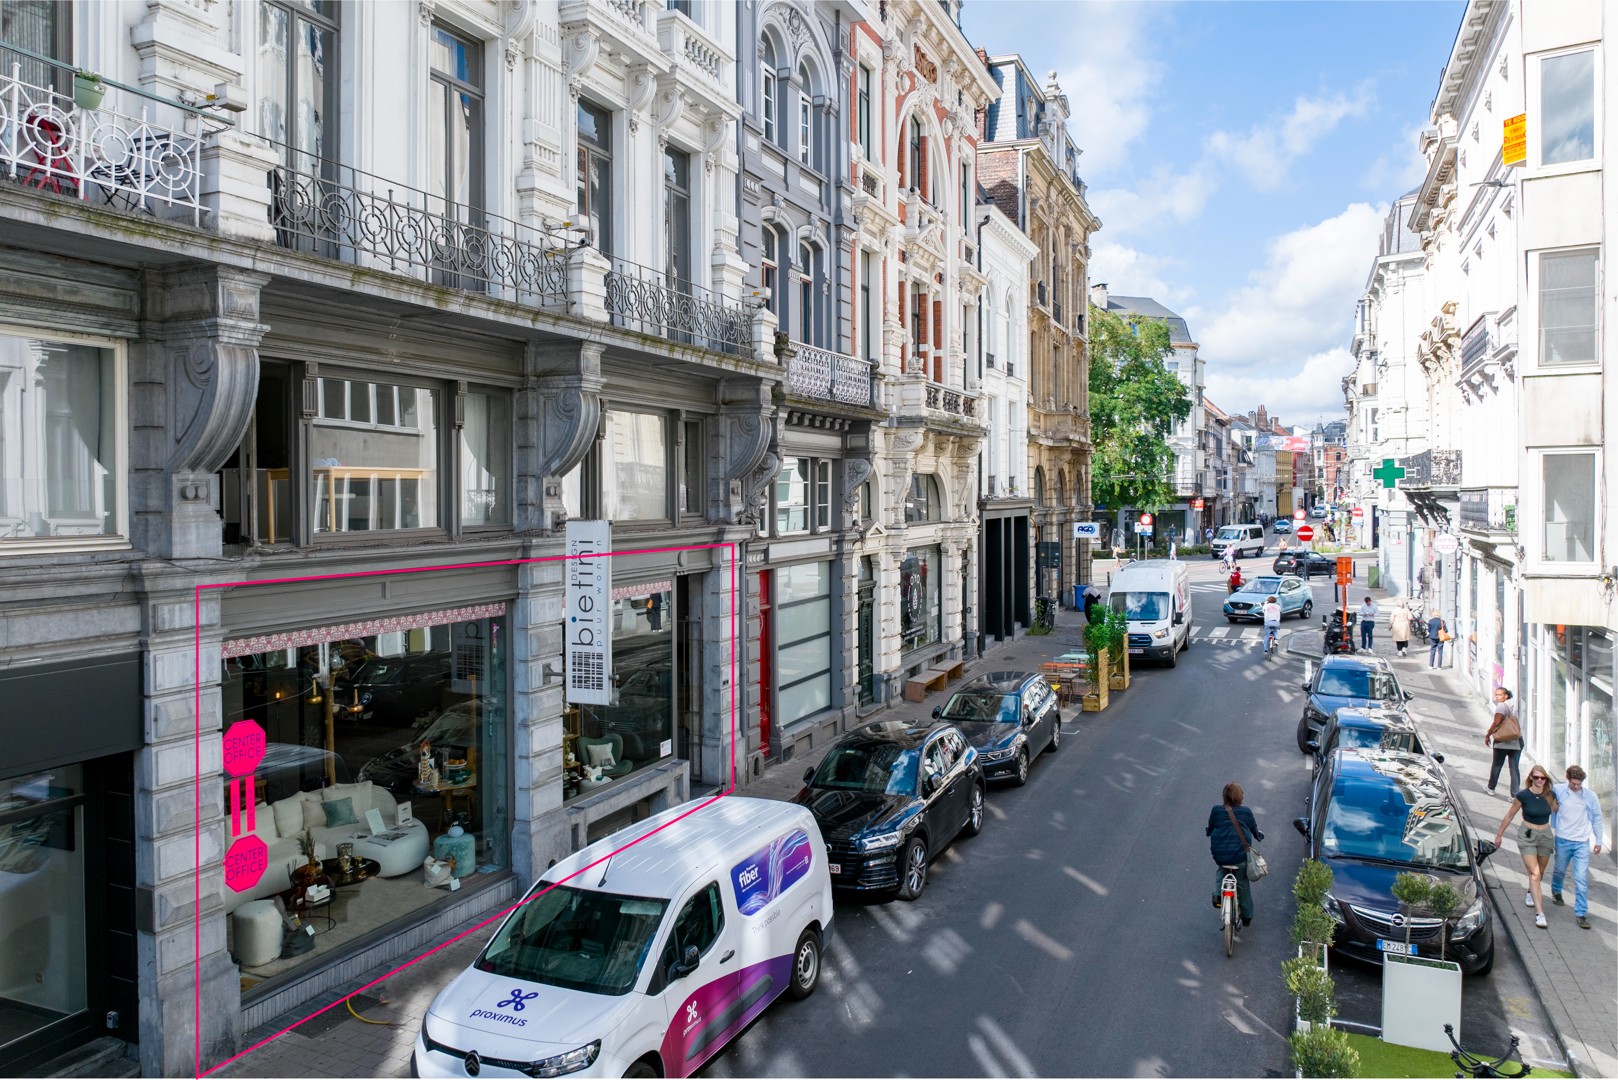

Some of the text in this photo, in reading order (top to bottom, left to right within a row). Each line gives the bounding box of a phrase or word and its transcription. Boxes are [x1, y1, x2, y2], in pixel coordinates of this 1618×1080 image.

[1513, 114, 1526, 124] KOO
[1077, 525, 1095, 533] AGO
[571, 540, 594, 647] bietini
[596, 609, 604, 647] puur
[224, 732, 262, 751] CENTER
[224, 745, 261, 764] OFFICE
[226, 846, 264, 868] CENTER
[226, 860, 263, 881] OFFICE
[738, 865, 760, 888] fiber
[764, 908, 781, 928] possible
[469, 1009, 528, 1027] proximus
